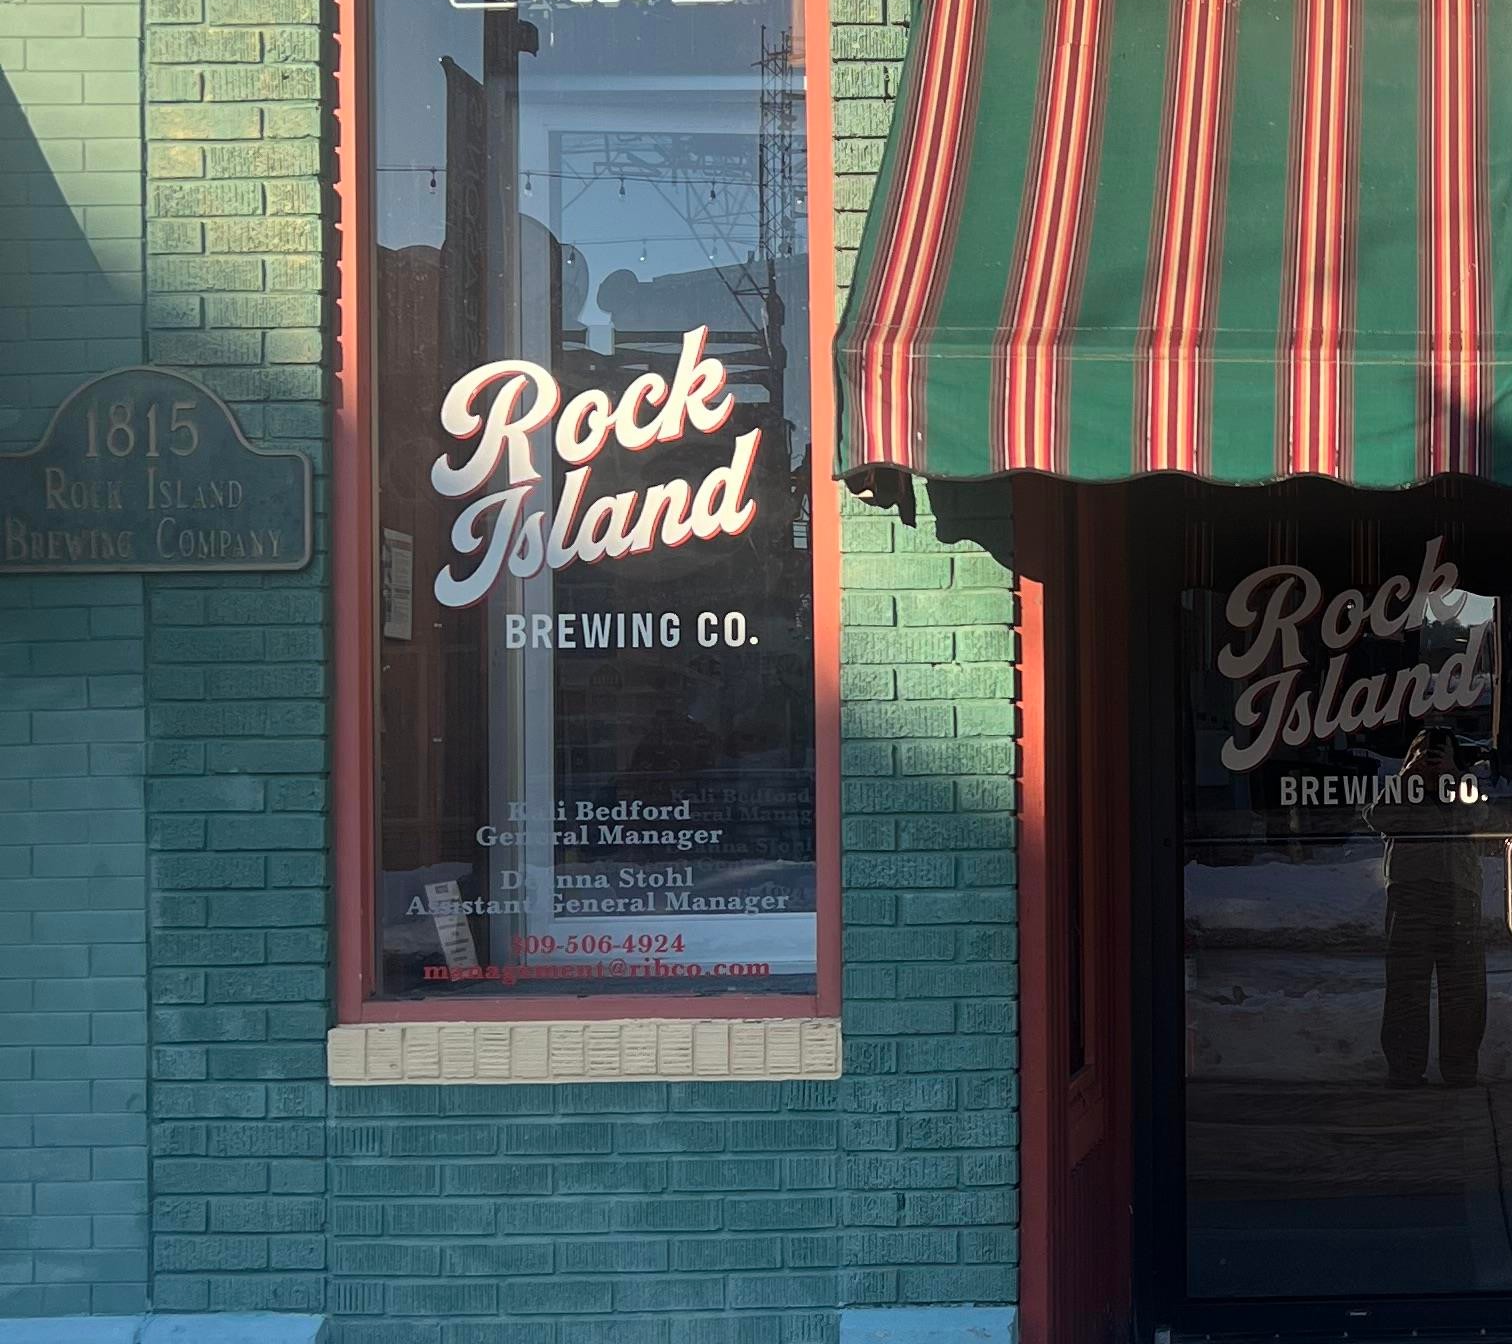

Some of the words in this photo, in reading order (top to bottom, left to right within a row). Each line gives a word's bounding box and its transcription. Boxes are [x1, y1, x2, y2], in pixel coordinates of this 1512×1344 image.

[84, 399, 200, 458] 1815
[431, 325, 735, 497] Rock
[433, 427, 763, 608] Island
[1217, 535, 1469, 679] Rock
[505, 612, 681, 650] BREWING
[696, 611, 760, 647] CO.
[1221, 622, 1493, 772] Island
[1280, 774, 1425, 806] BREWING
[1438, 773, 1489, 804] CO.
[508, 800, 568, 821] Ki
[575, 800, 691, 821] Bedford
[476, 825, 590, 847] Genral
[598, 825, 723, 850] Manager
[500, 870, 610, 890] Dnna
[619, 867, 695, 887] Stohl
[664, 892, 790, 914] Manager
